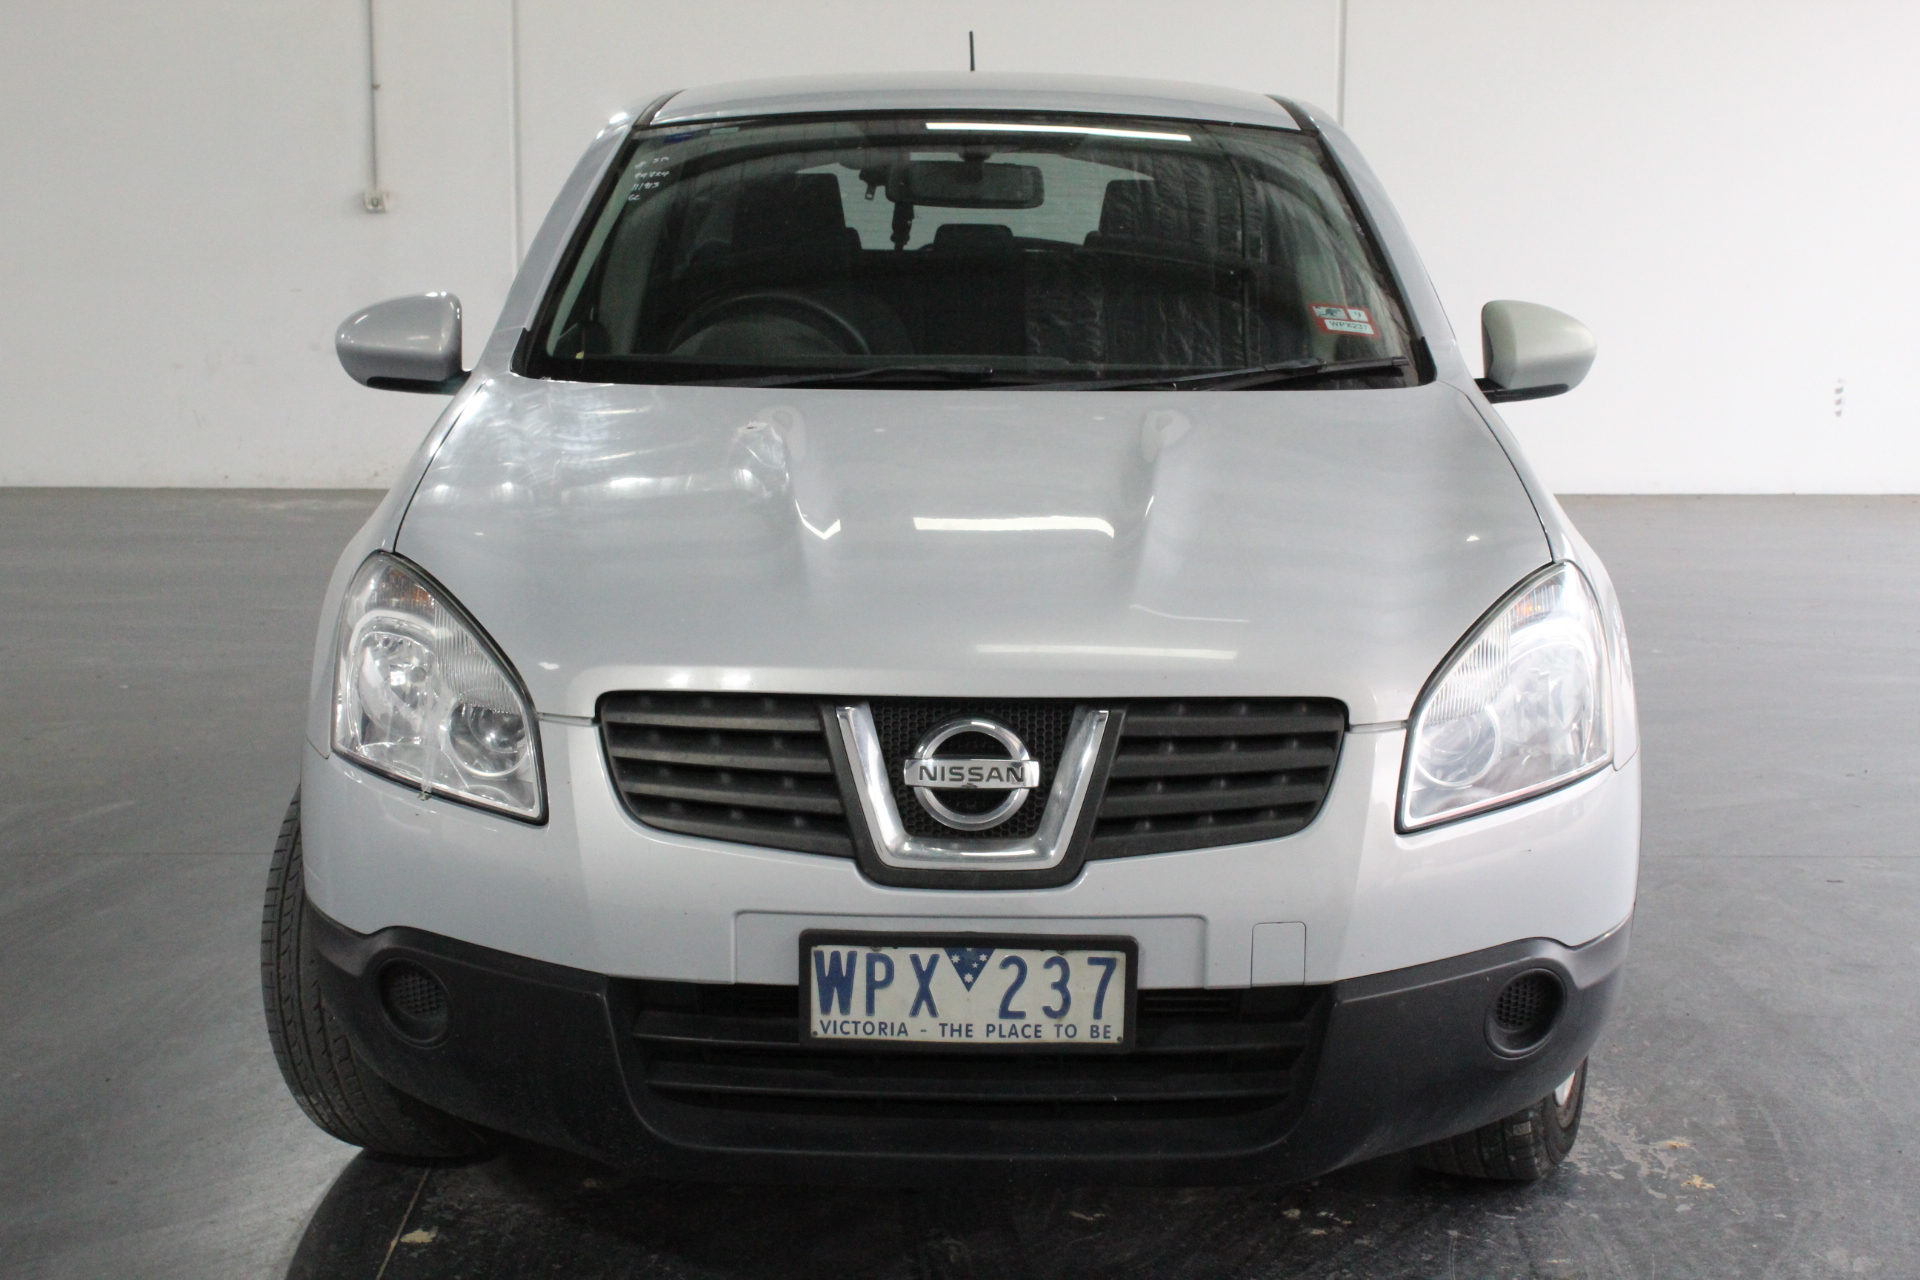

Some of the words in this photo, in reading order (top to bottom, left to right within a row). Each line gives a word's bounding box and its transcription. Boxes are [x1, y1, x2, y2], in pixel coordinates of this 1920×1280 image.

[1328, 320, 1368, 330] WPX237
[918, 765, 1025, 783] NISSAN
[813, 950, 941, 1018] WPX
[998, 955, 1118, 1020] 237
[819, 1019, 909, 1037] VICTORIA
[938, 1022, 974, 1038] THE
[986, 1023, 1043, 1039] PLACE
[1053, 1023, 1078, 1039] TO
[1090, 1024, 1112, 1040] BE
